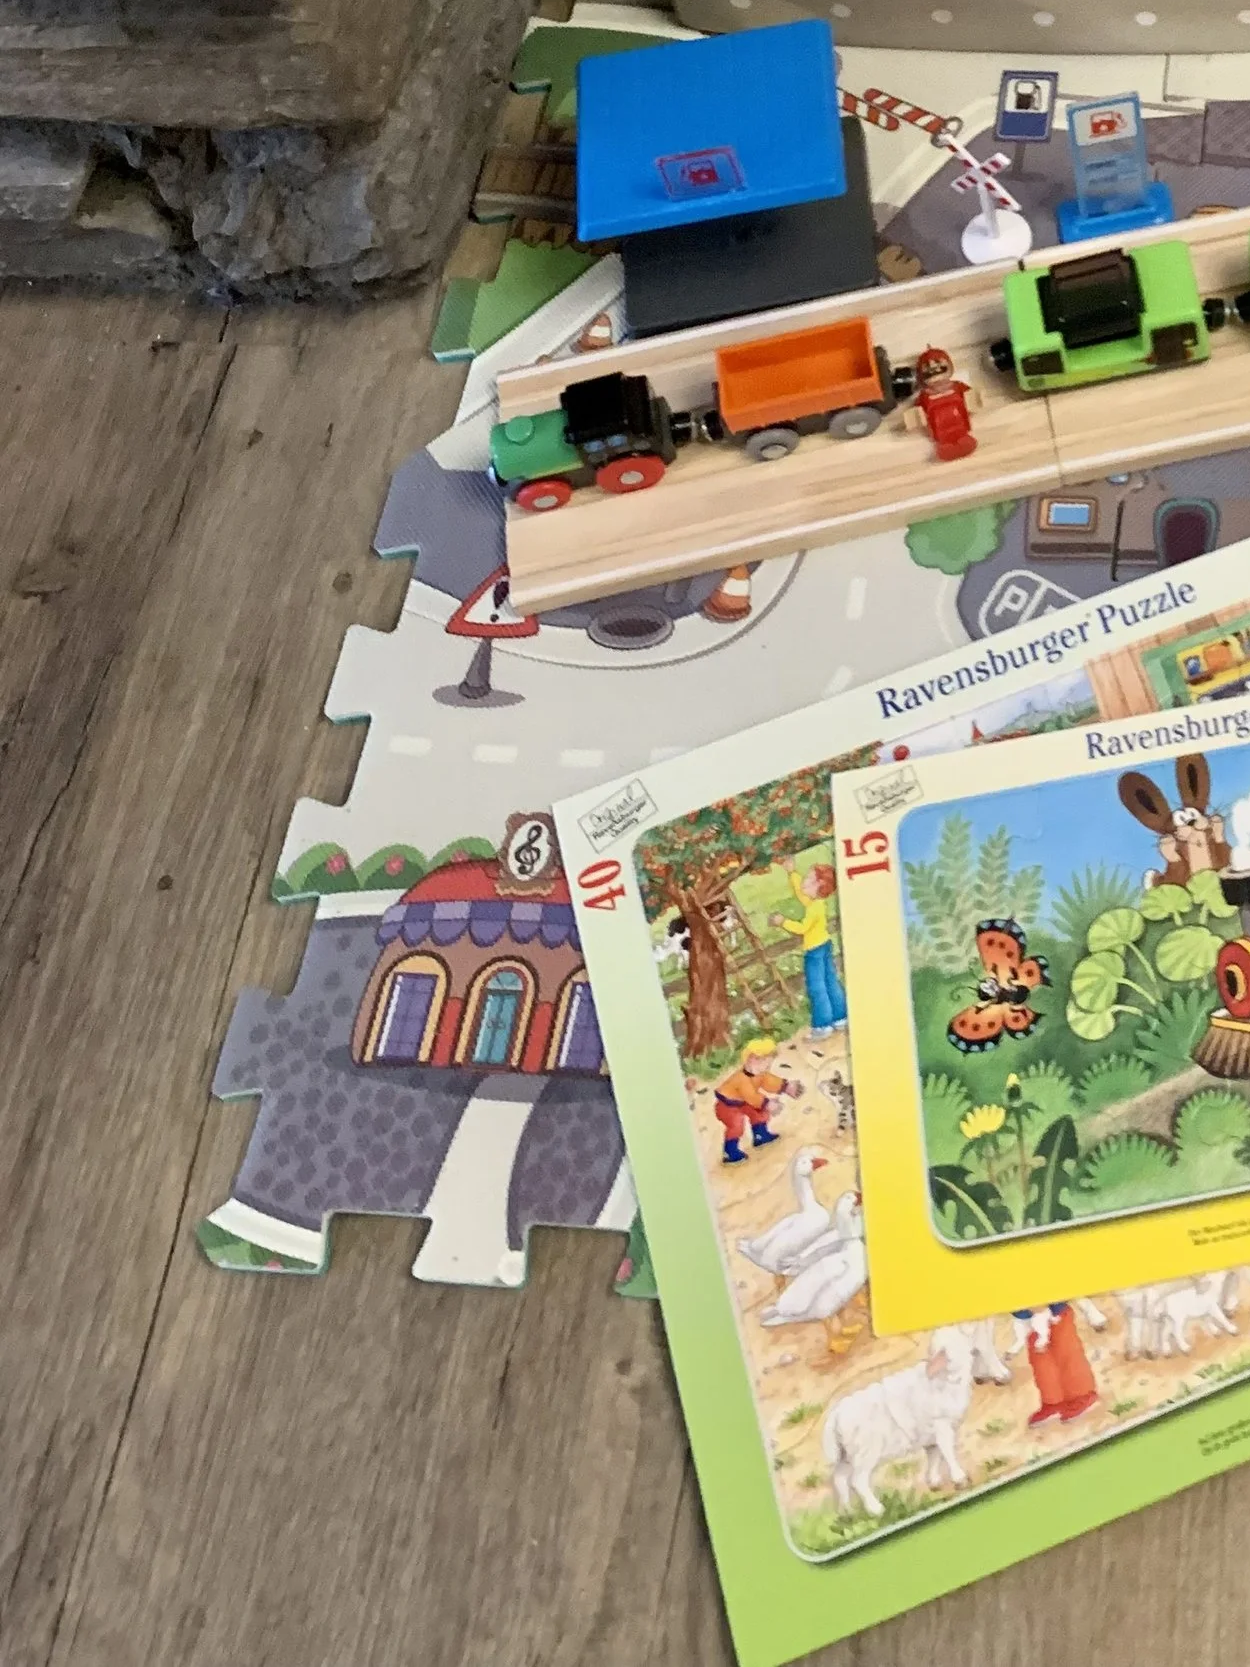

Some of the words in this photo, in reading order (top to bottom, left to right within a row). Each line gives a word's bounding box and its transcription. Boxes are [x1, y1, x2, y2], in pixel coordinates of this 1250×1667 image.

[875, 620, 1093, 719] Ravensburger
[1096, 581, 1198, 634] Puzzle
[843, 830, 891, 880] 15
[577, 859, 626, 911] 40
